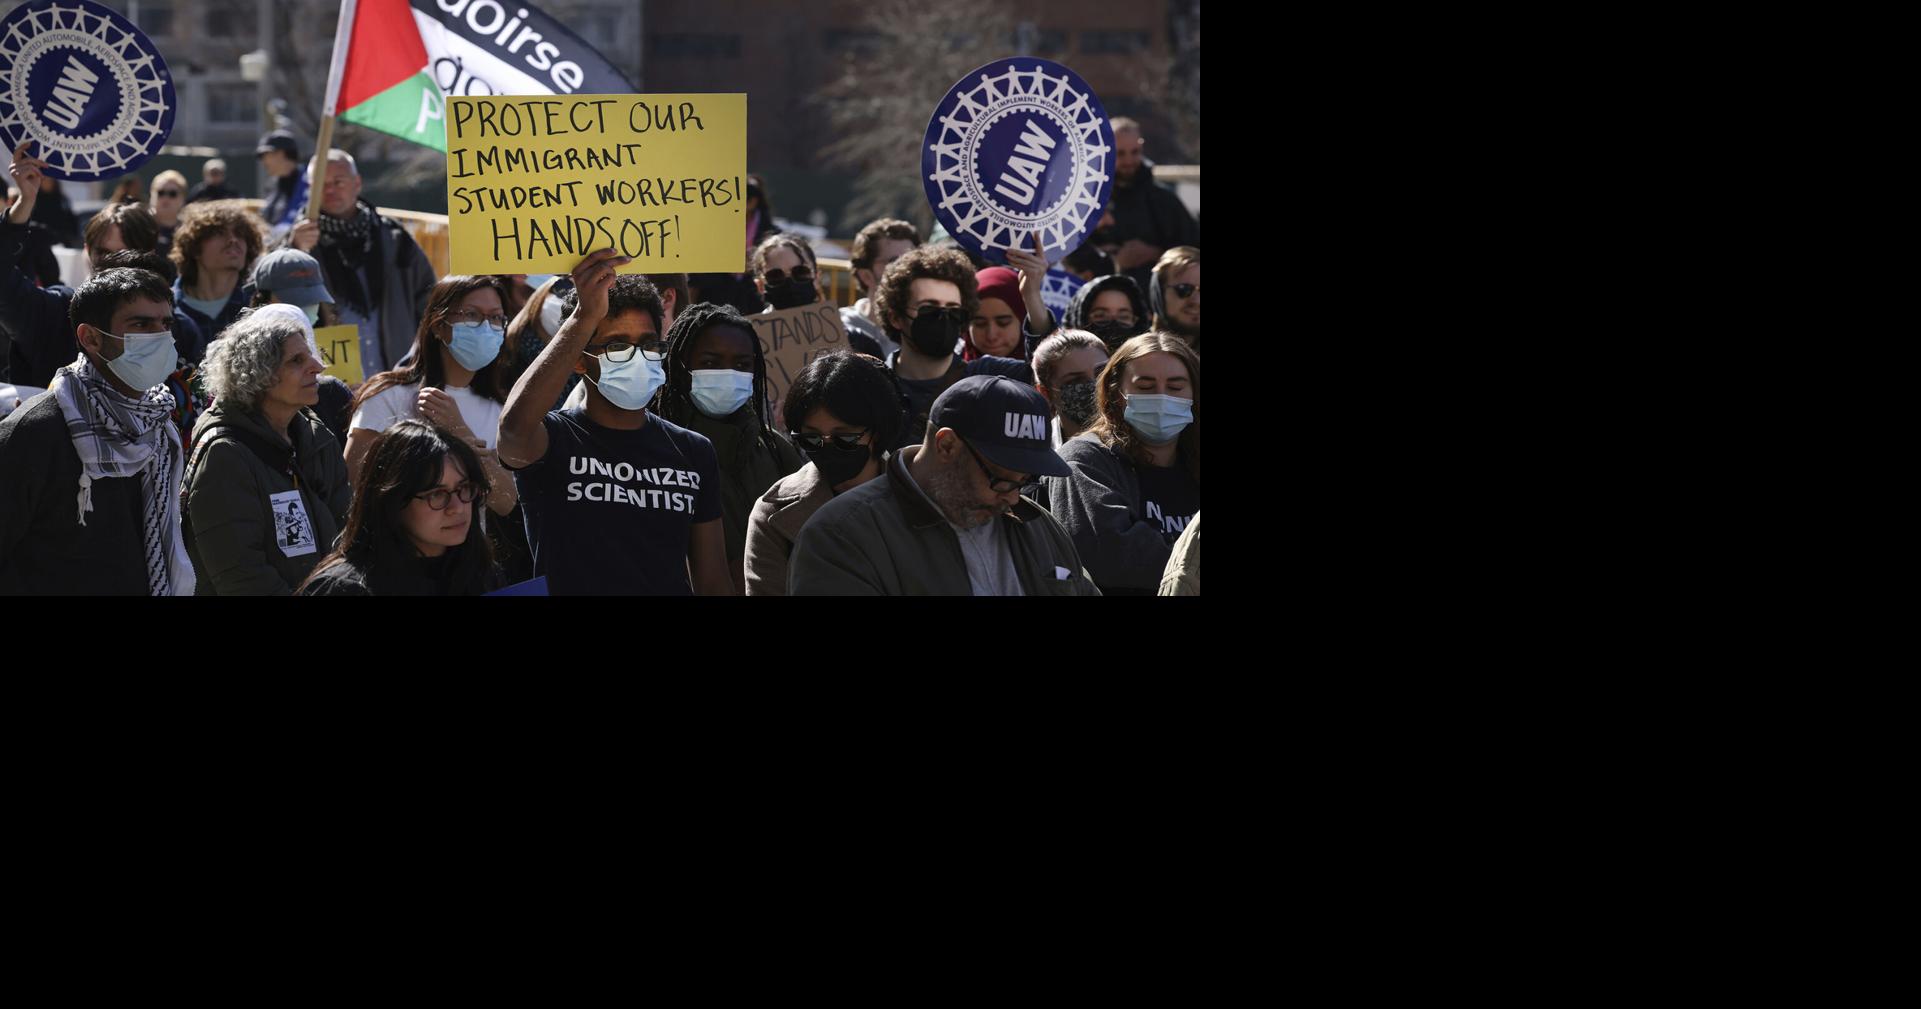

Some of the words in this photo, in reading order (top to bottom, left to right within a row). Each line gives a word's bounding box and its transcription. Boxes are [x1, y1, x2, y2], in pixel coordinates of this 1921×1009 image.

[42, 55, 100, 130] UAW
[996, 95, 1038, 108] IMPLEMENT
[1039, 99, 1069, 121] WORKERS
[453, 100, 618, 138] PROTECT
[629, 102, 704, 133] OUR
[964, 106, 997, 153] AGRICULTURAL
[451, 144, 642, 178] IMMIGRANT
[994, 119, 1057, 206] UAW
[452, 181, 583, 214] STUDENT
[595, 176, 741, 213] WORKERS!
[964, 174, 987, 211] AEROSPACE
[491, 215, 615, 261] HANDS
[620, 215, 681, 259] OFF!
[1004, 411, 1046, 440] UAW
[569, 456, 701, 490] UNIONIZED
